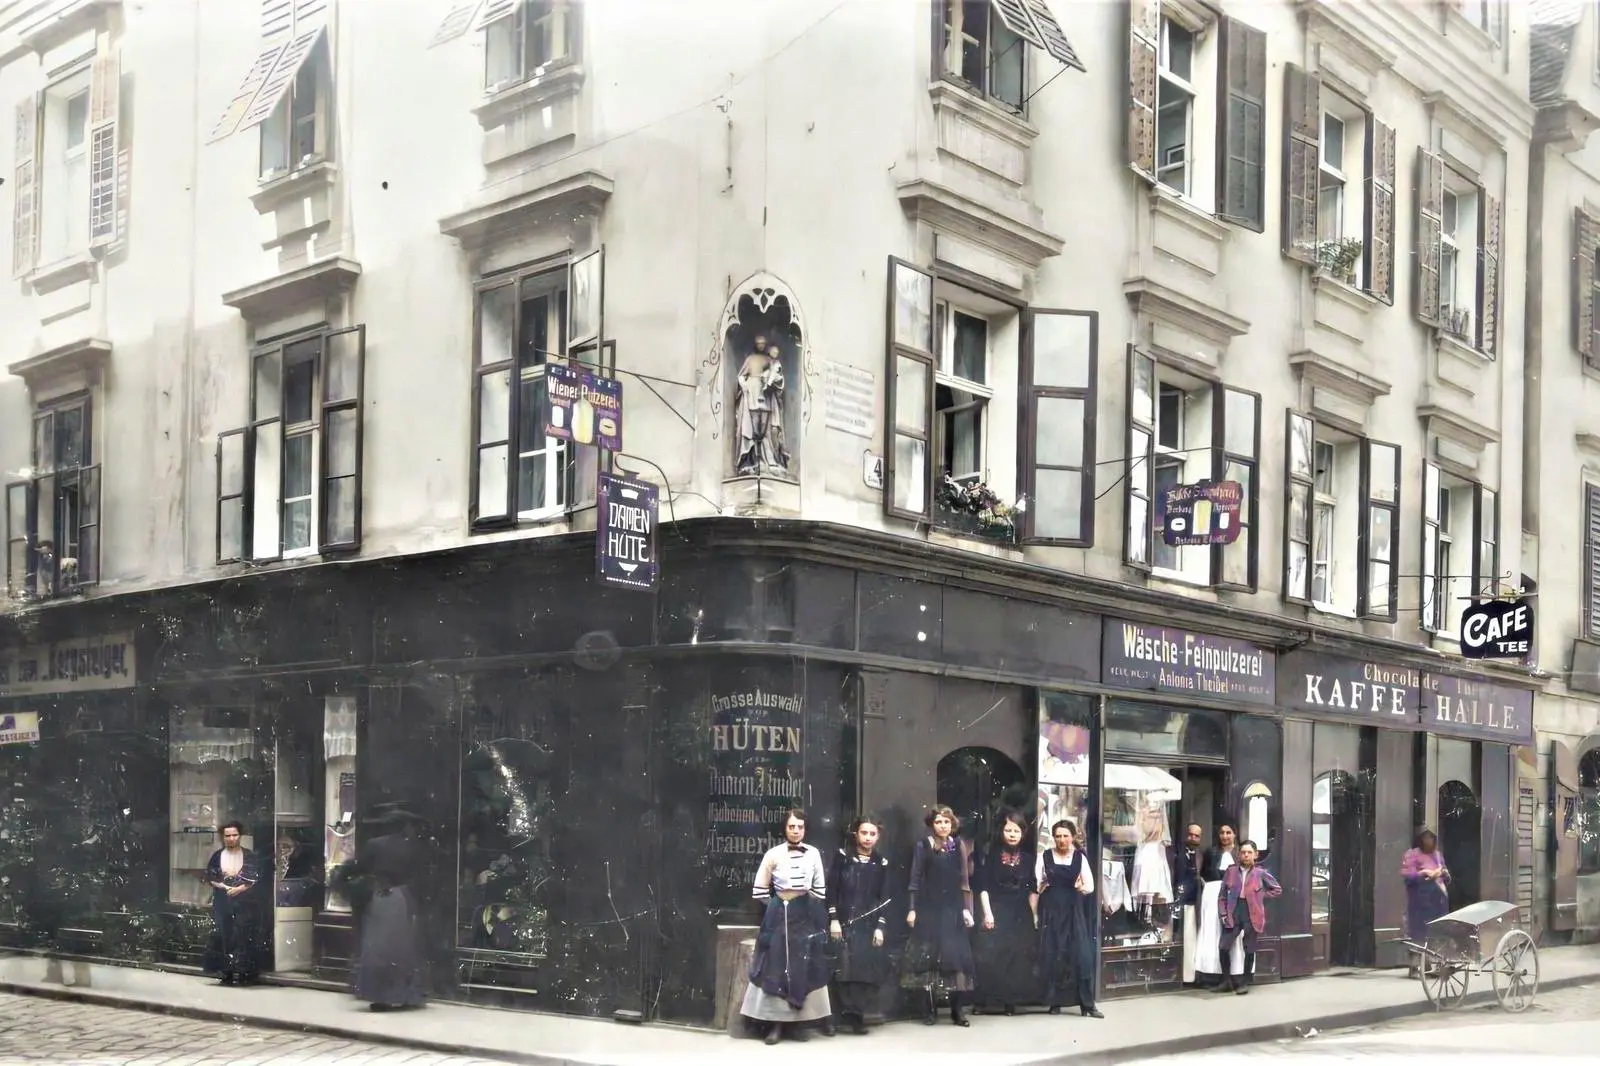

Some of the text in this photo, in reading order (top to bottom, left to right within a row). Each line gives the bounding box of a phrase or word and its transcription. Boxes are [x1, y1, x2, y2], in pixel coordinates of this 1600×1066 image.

[547, 375, 578, 399] Wiener
[608, 502, 650, 534] DAMEN
[608, 532, 650, 563] HÜTE
[1496, 640, 1528, 653] TEE
[1364, 663, 1439, 692] Chocolade
[711, 689, 804, 714] Grosse Auswahl
[1305, 673, 1407, 716] KAFFE
[711, 717, 801, 753] HÜTEN
